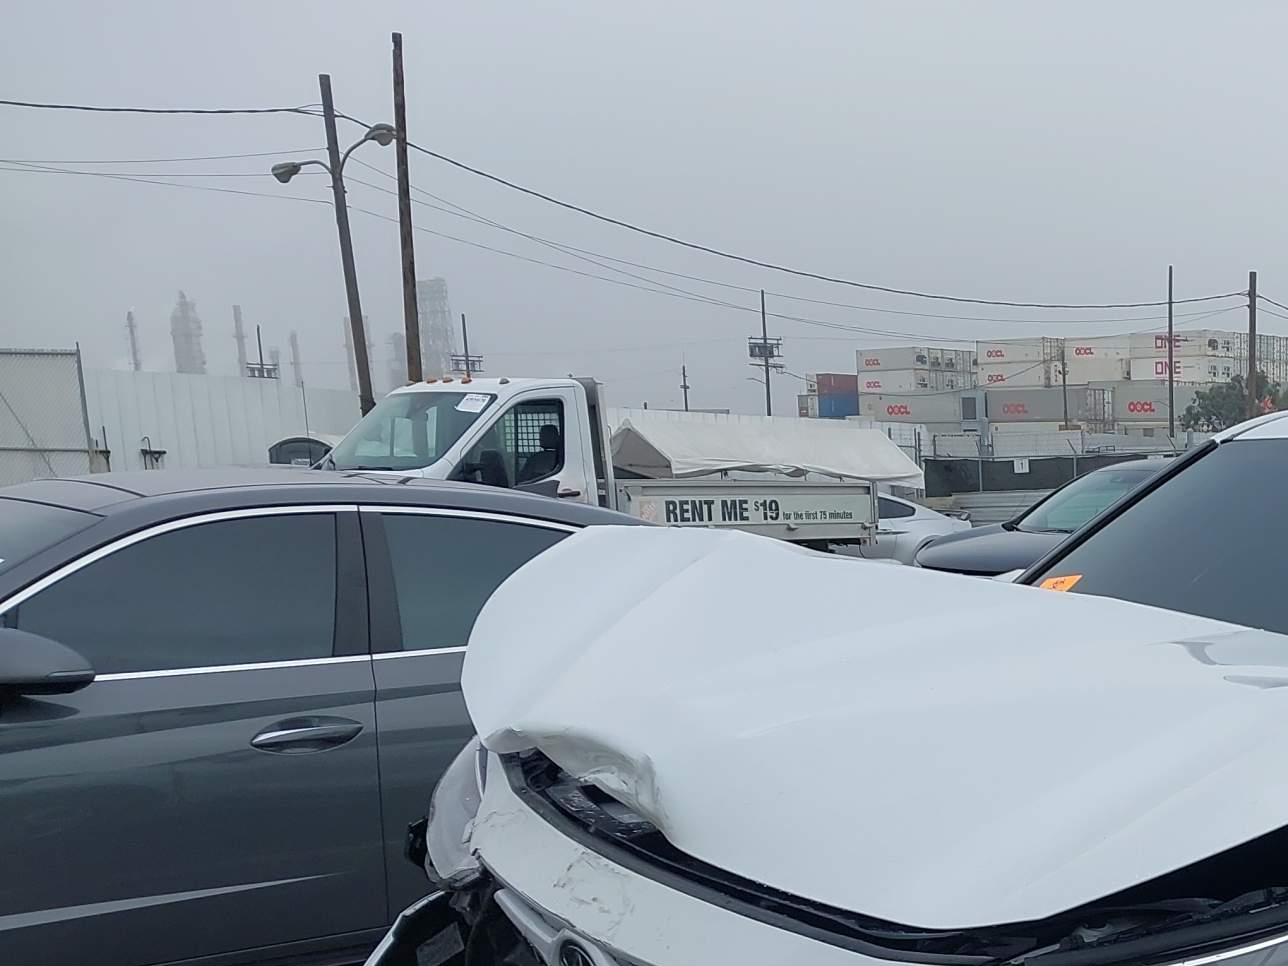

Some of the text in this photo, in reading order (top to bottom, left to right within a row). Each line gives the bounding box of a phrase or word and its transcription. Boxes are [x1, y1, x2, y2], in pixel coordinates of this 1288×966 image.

[887, 404, 911, 415] OOCL
[1128, 402, 1156, 413] OOCL
[665, 499, 715, 523] RENT
[721, 498, 750, 522] ME
[753, 499, 780, 522] $19
